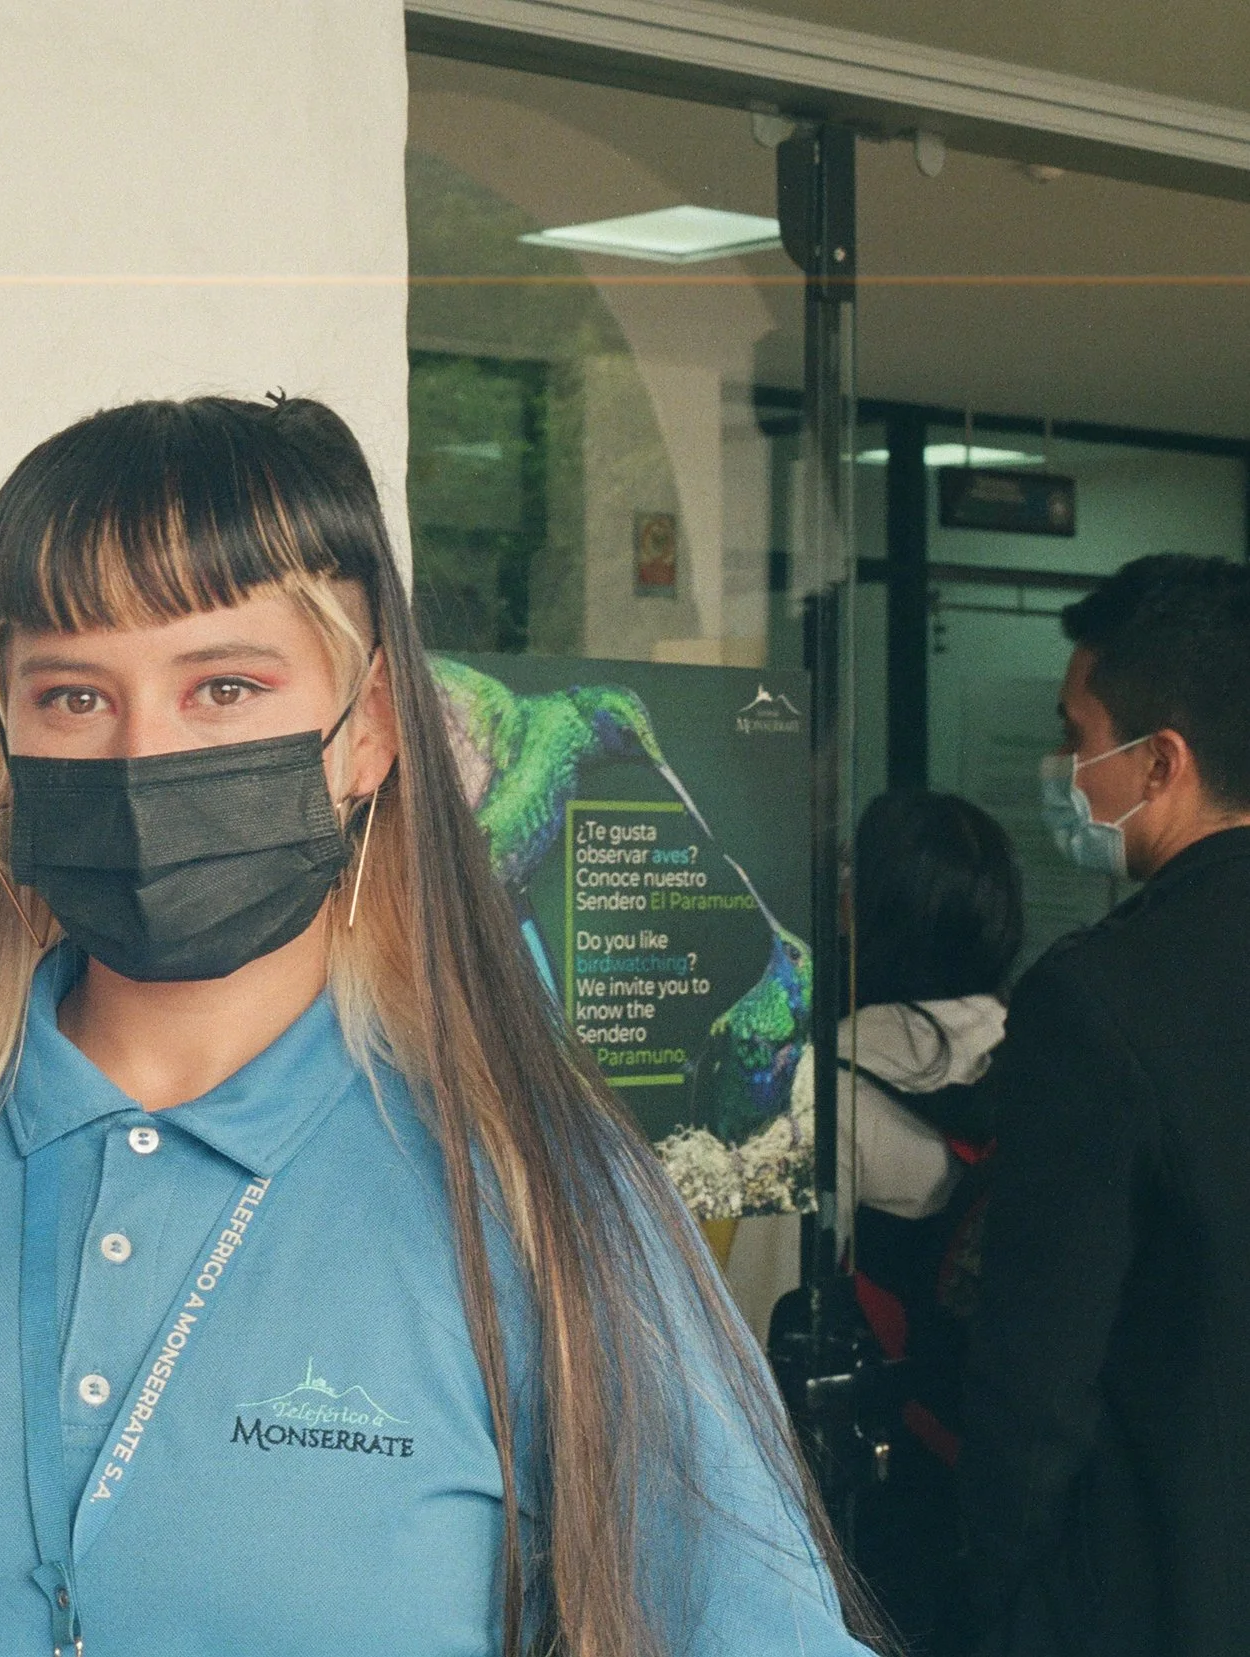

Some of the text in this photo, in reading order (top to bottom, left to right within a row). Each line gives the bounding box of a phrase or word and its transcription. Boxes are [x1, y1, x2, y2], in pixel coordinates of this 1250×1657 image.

[577, 821, 657, 845] ¿Te gusta
[576, 845, 698, 864] observar aves?
[576, 868, 707, 887] Conoce nuestro
[576, 891, 646, 910] Sendero
[651, 891, 665, 910] El
[577, 930, 668, 954] Do you like
[576, 976, 710, 999] We invite you to
[577, 1000, 655, 1019] know the
[576, 1023, 647, 1043] Sendero
[184, 1292, 205, 1307] A
[113, 1312, 198, 1463] MONSERRATE
[230, 1415, 414, 1457] MONSERRATE
